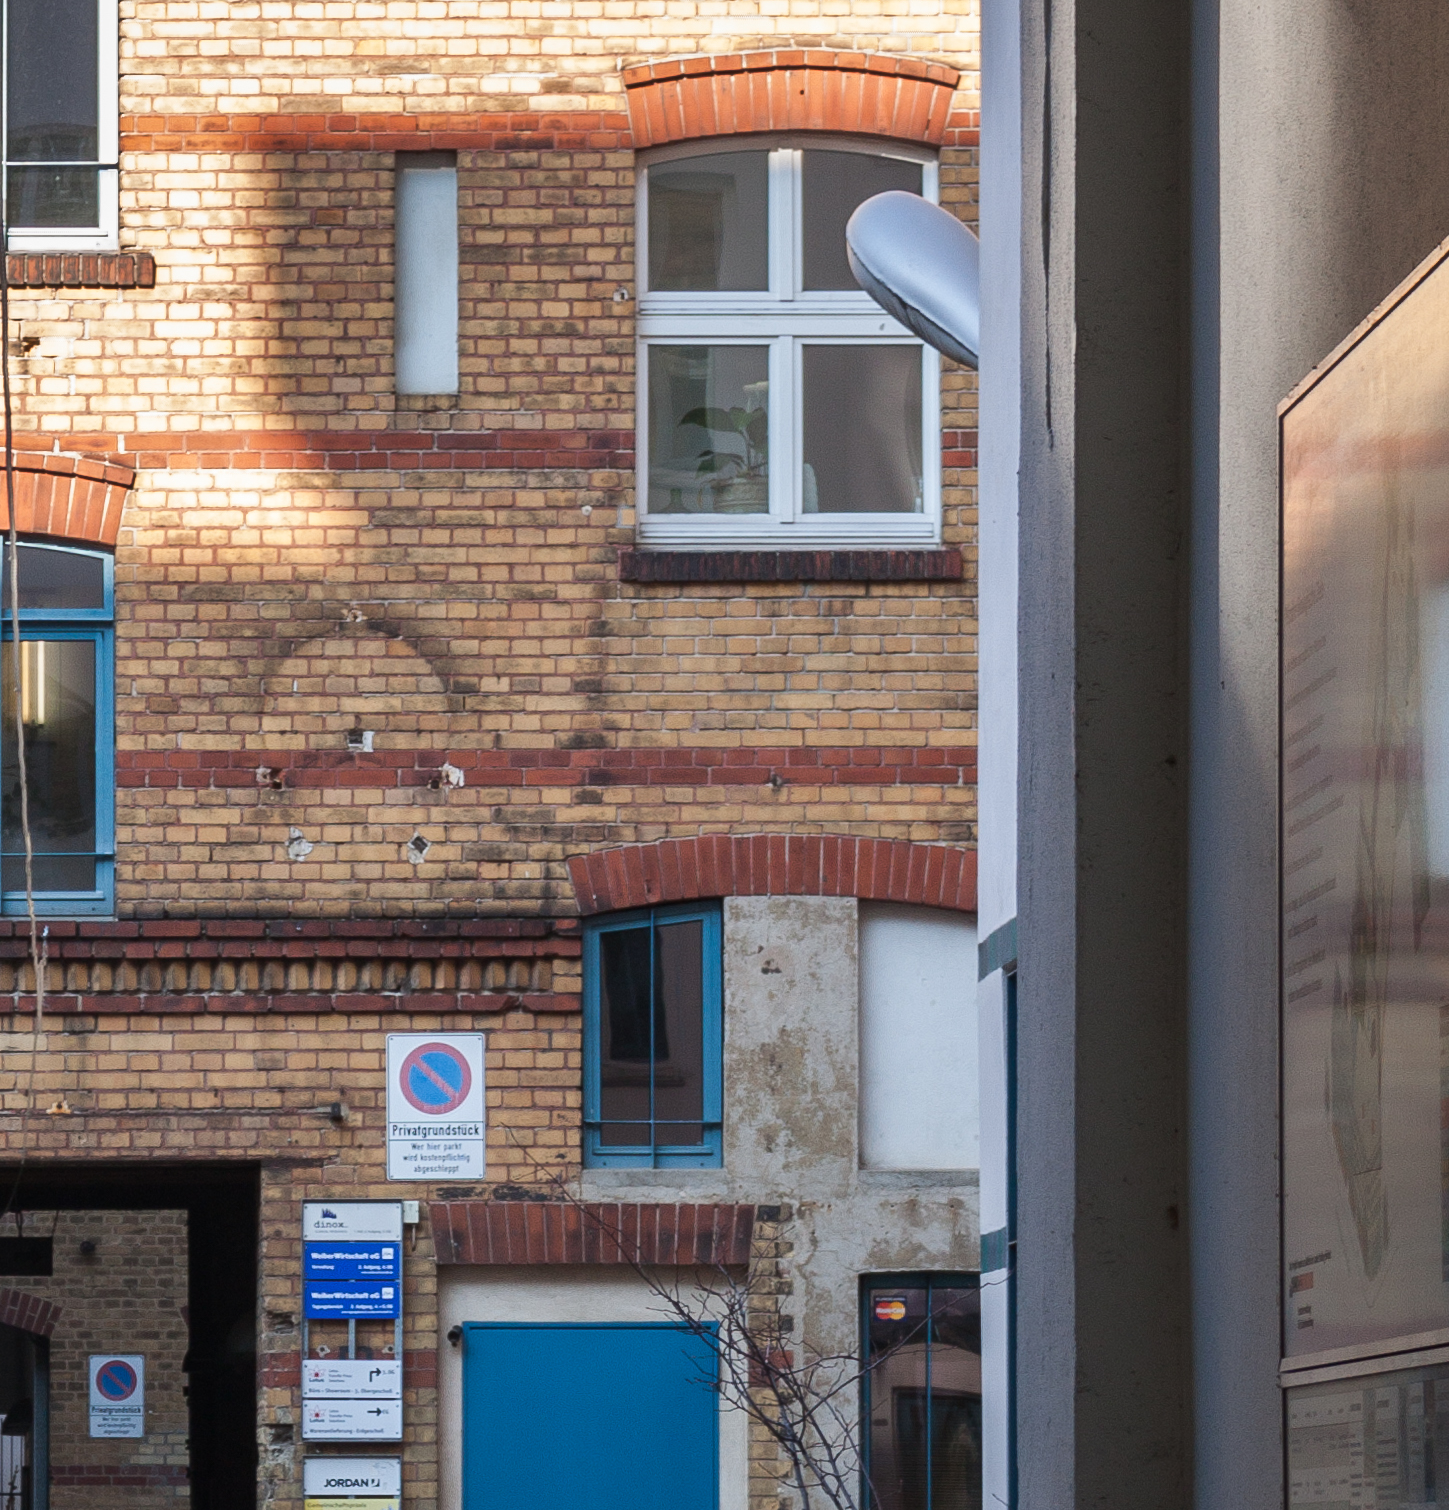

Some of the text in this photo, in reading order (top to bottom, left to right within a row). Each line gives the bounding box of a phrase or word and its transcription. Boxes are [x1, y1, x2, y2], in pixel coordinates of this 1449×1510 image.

[392, 1124, 480, 1138] Privatgrundstück
[444, 1143, 462, 1152] parkt
[420, 1154, 470, 1163] kostenpflichtig
[414, 1165, 459, 1174] abgeschleppt
[311, 1252, 369, 1260] WeiberWirtschaft
[324, 1478, 369, 1487] JORDAN
